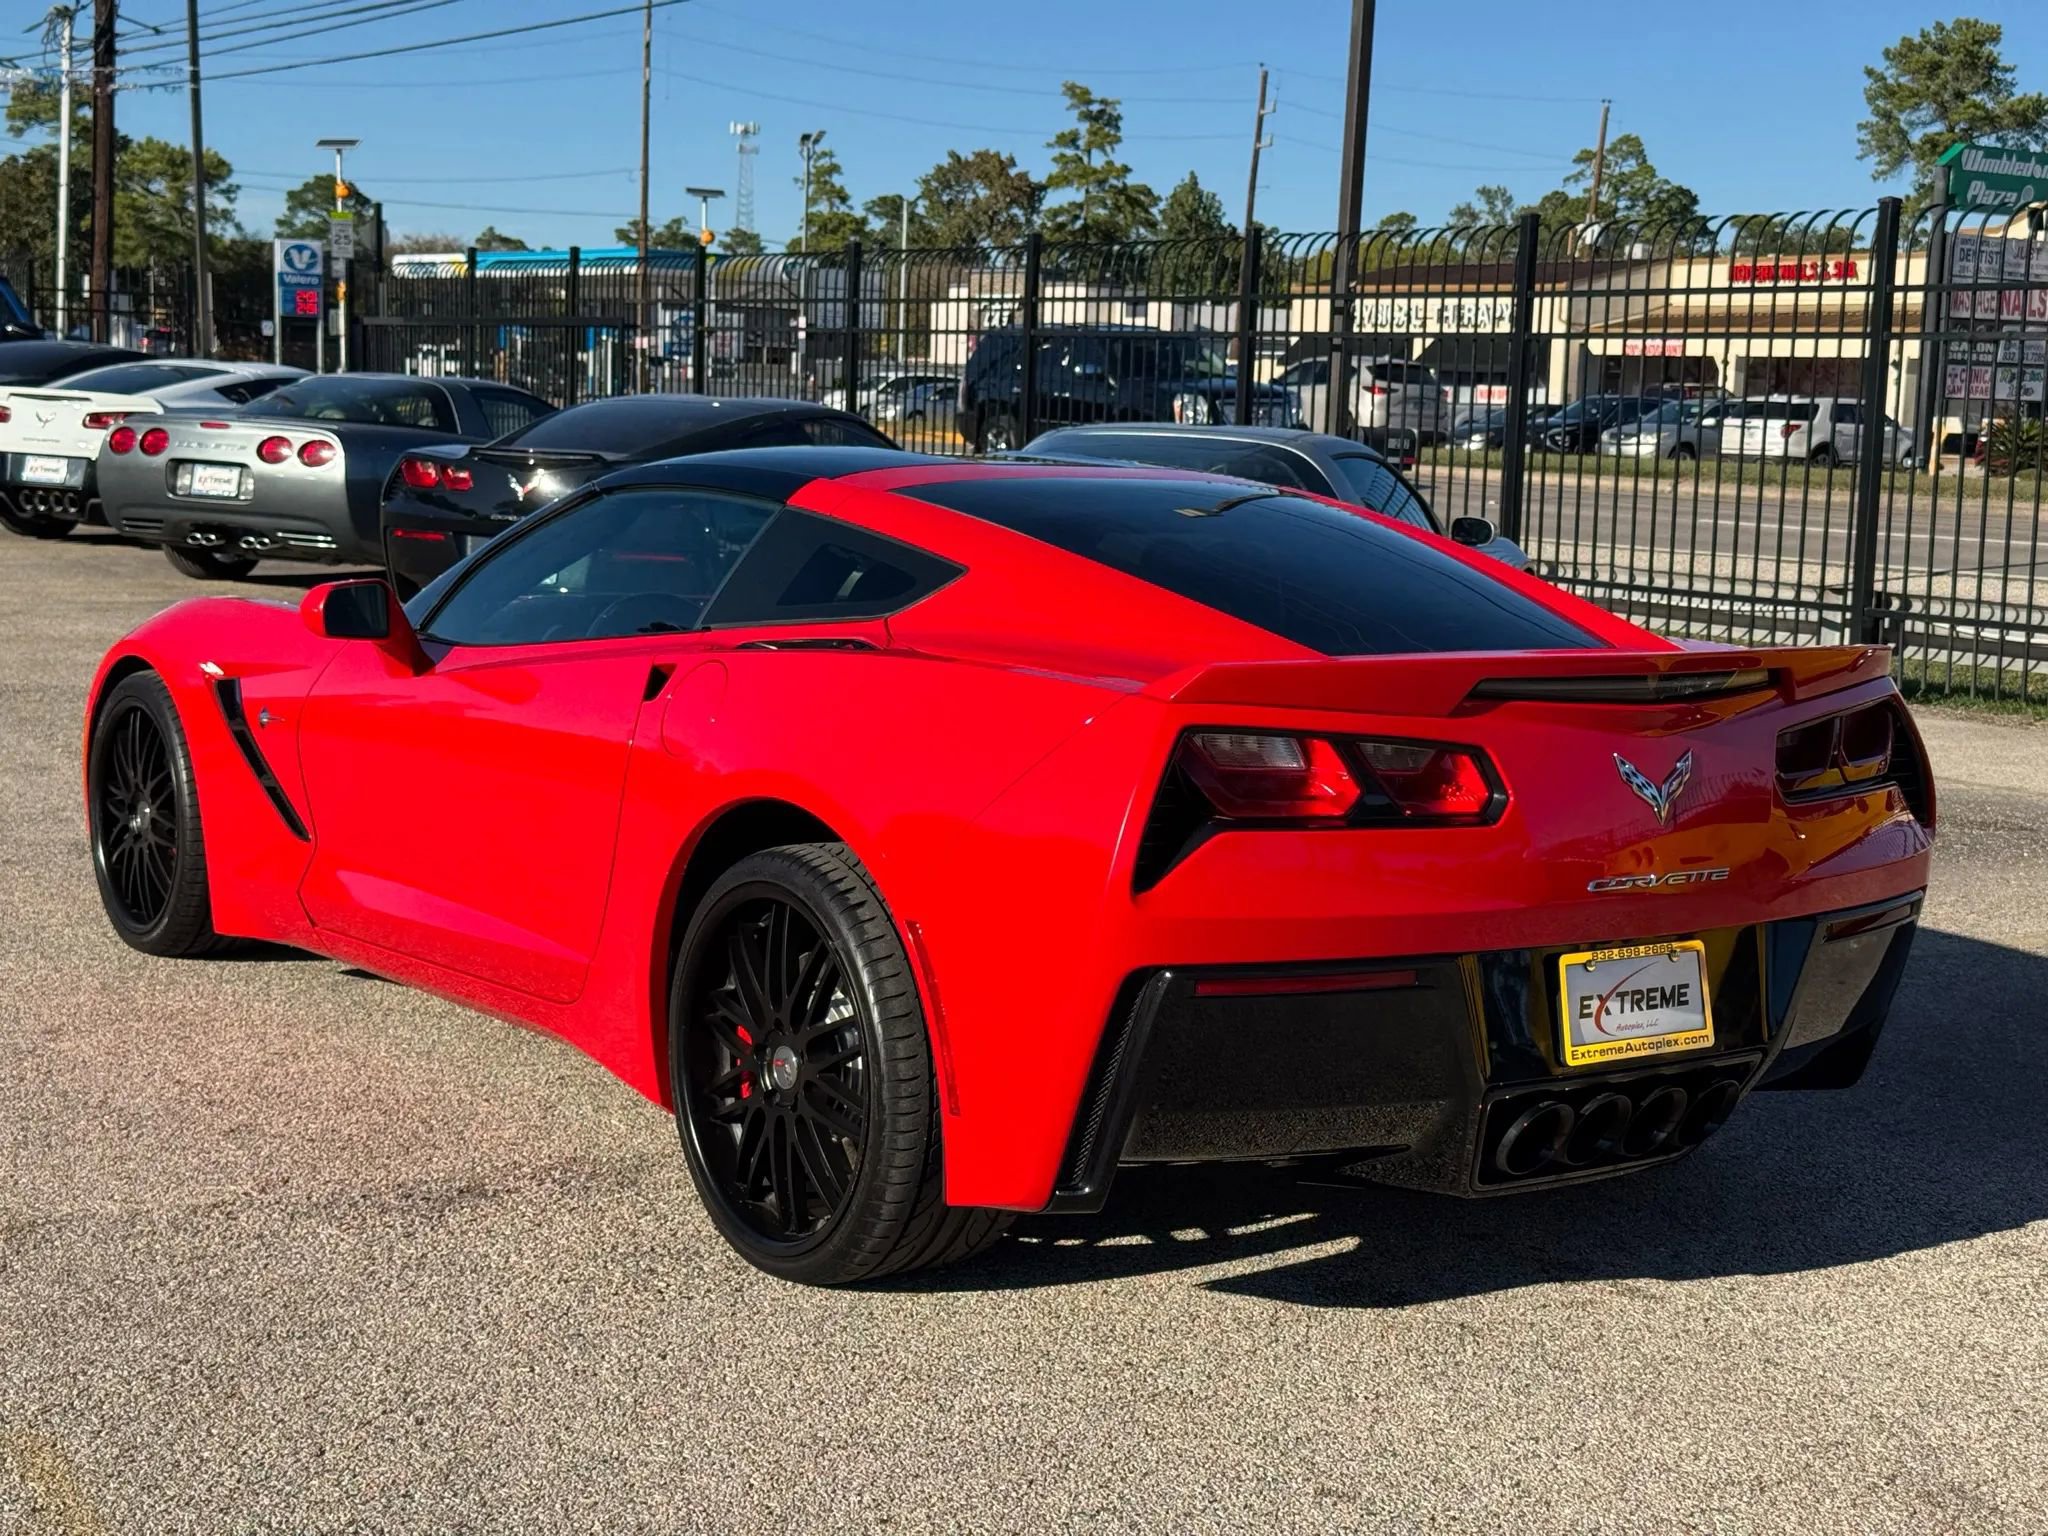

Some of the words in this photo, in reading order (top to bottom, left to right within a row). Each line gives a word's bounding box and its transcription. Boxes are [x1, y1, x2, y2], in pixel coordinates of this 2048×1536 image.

[1967, 181, 2018, 206] Plaza
[334, 234, 352, 245] 25
[283, 274, 320, 285] Valero
[1951, 288, 1997, 314] MASAGE
[1999, 287, 2048, 318] NALS
[1587, 867, 1731, 892] CORVETTE
[1579, 982, 1690, 1020] EXTREME
[1571, 1033, 1710, 1061] ExtremeAutoplex.com
